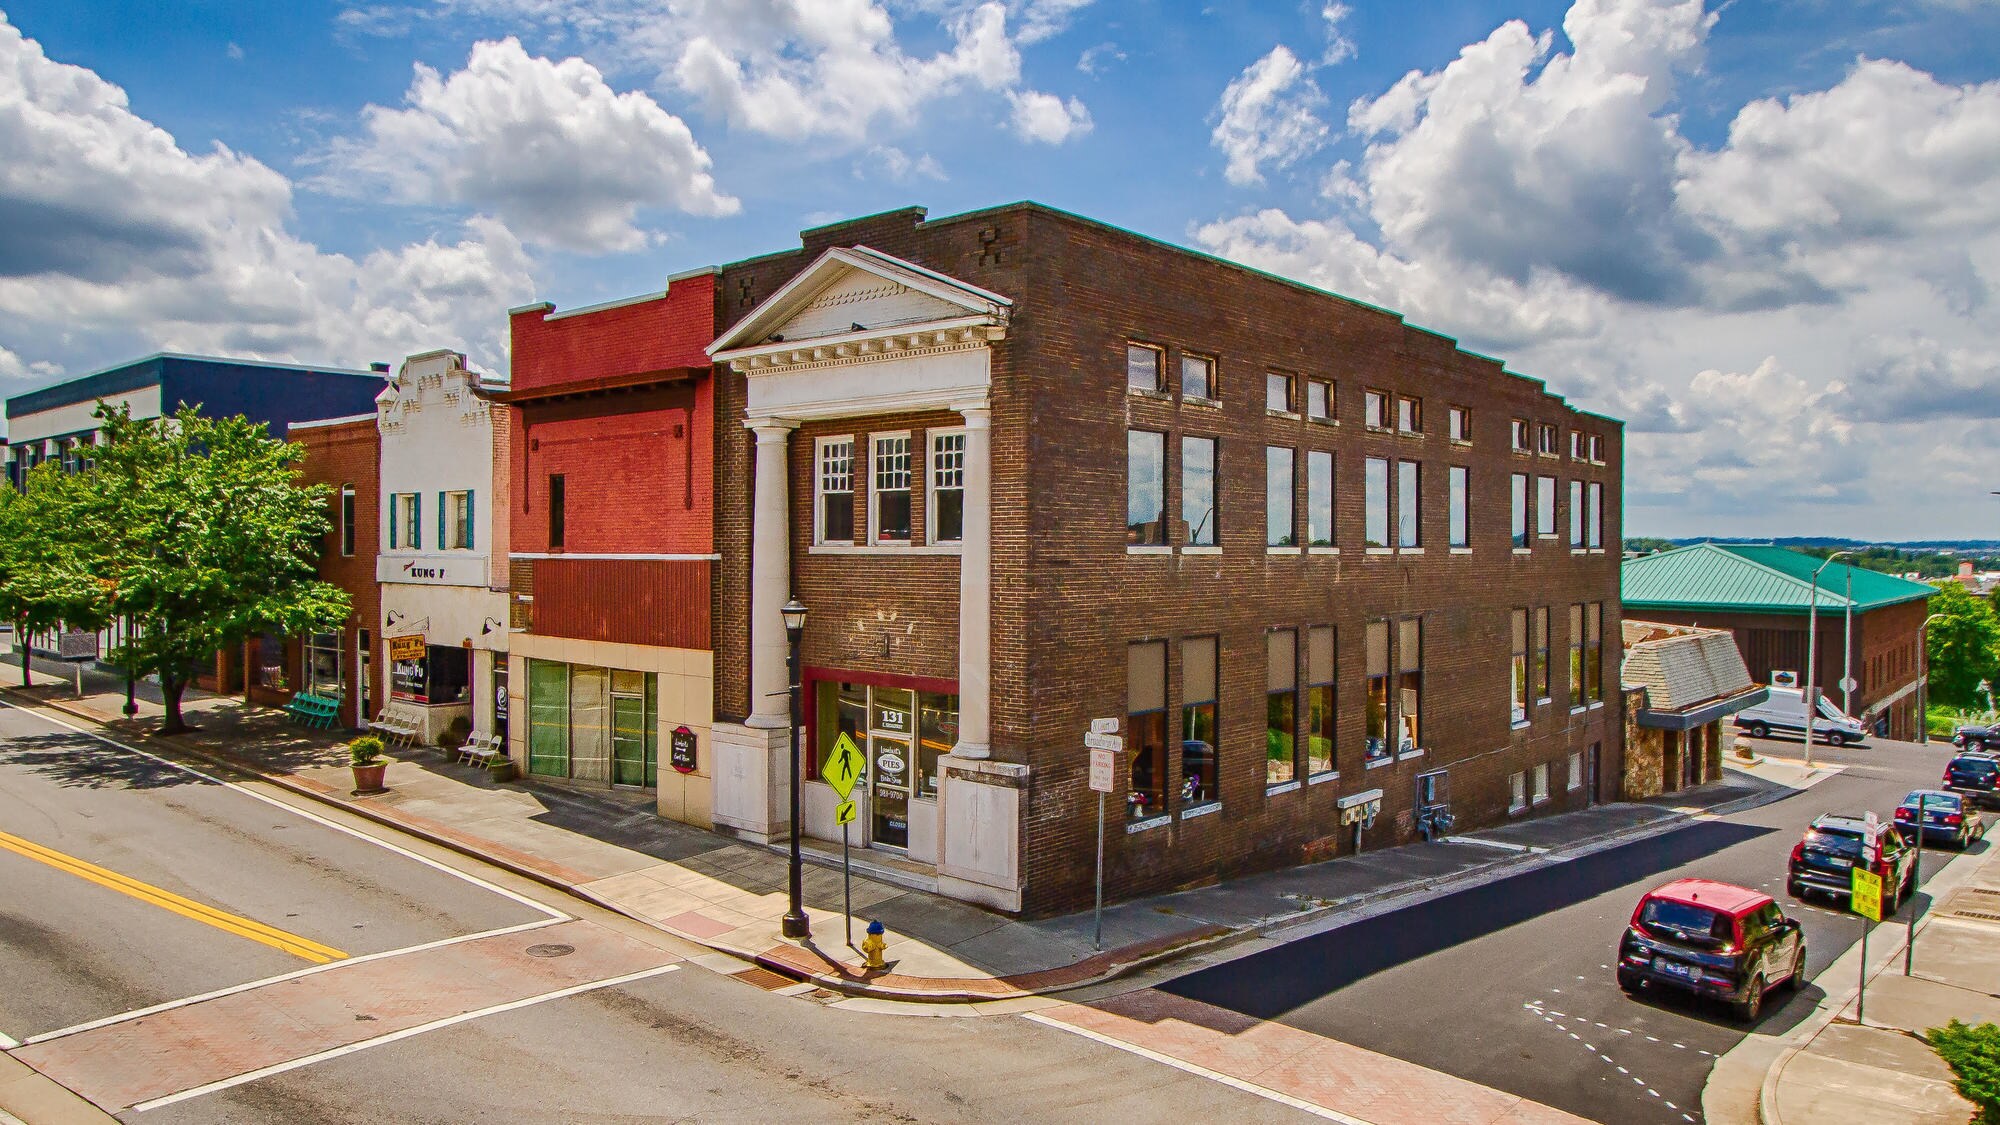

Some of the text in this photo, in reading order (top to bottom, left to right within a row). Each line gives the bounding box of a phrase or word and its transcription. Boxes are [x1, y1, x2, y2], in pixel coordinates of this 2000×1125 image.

[411, 567, 435, 578] KUNG
[881, 710, 904, 724] 131
[882, 759, 901, 769] PIES
[889, 821, 907, 829] CLOSED
